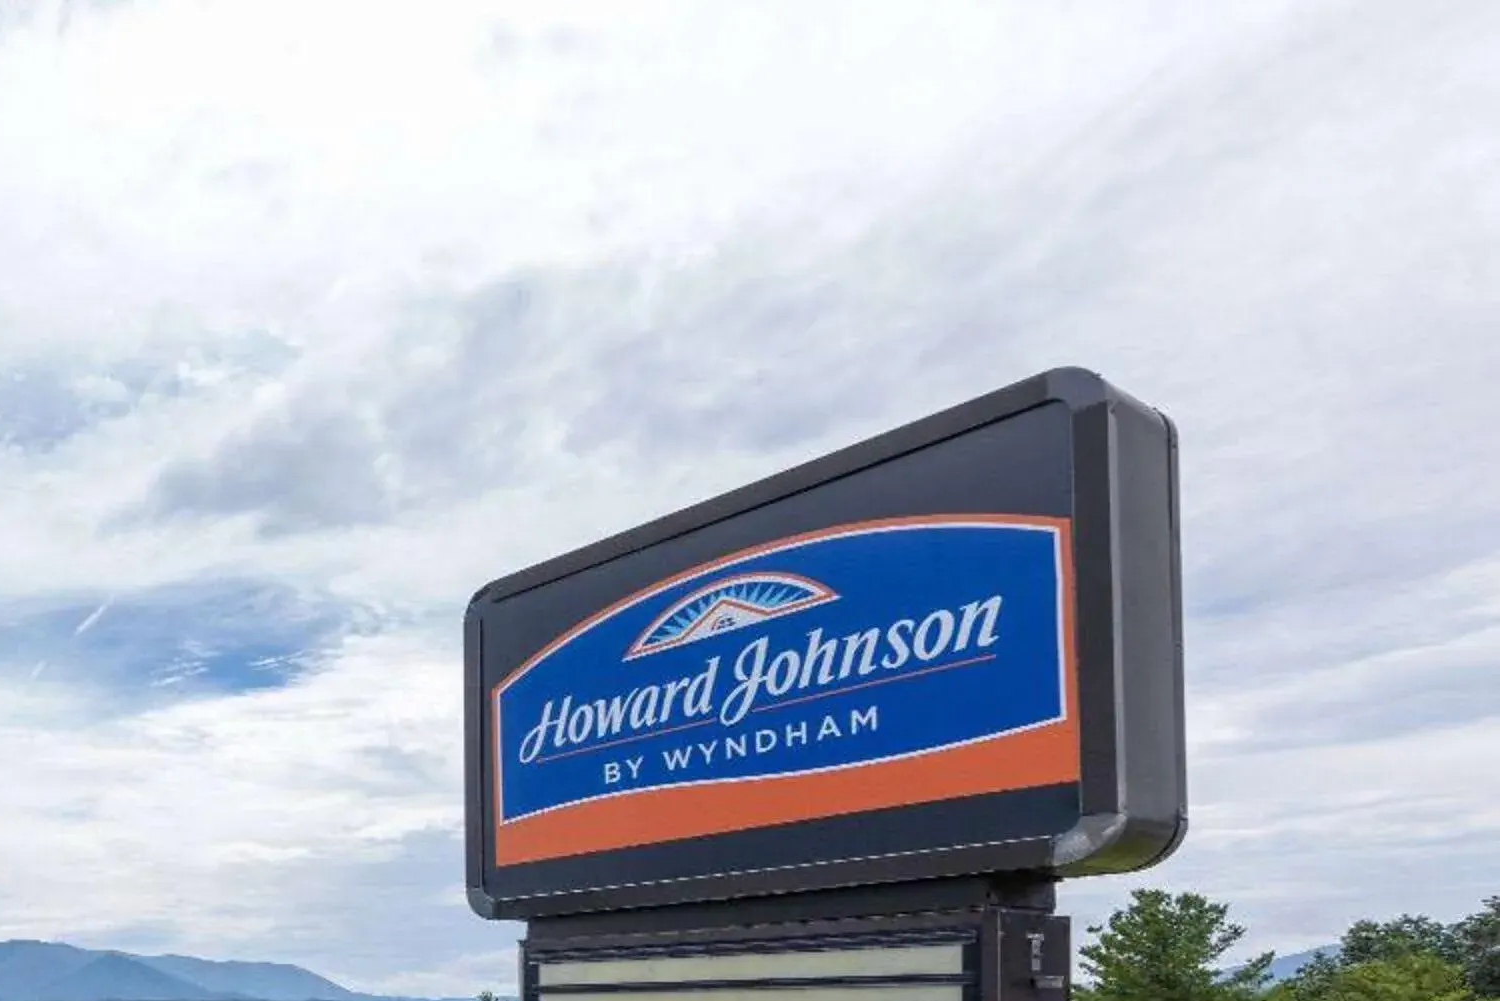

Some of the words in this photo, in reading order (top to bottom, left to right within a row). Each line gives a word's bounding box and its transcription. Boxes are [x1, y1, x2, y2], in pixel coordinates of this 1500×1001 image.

[519, 656, 721, 763] Howard
[719, 595, 1002, 726] Johnson
[604, 756, 644, 784] BY
[663, 706, 878, 770] WYNDHAM
